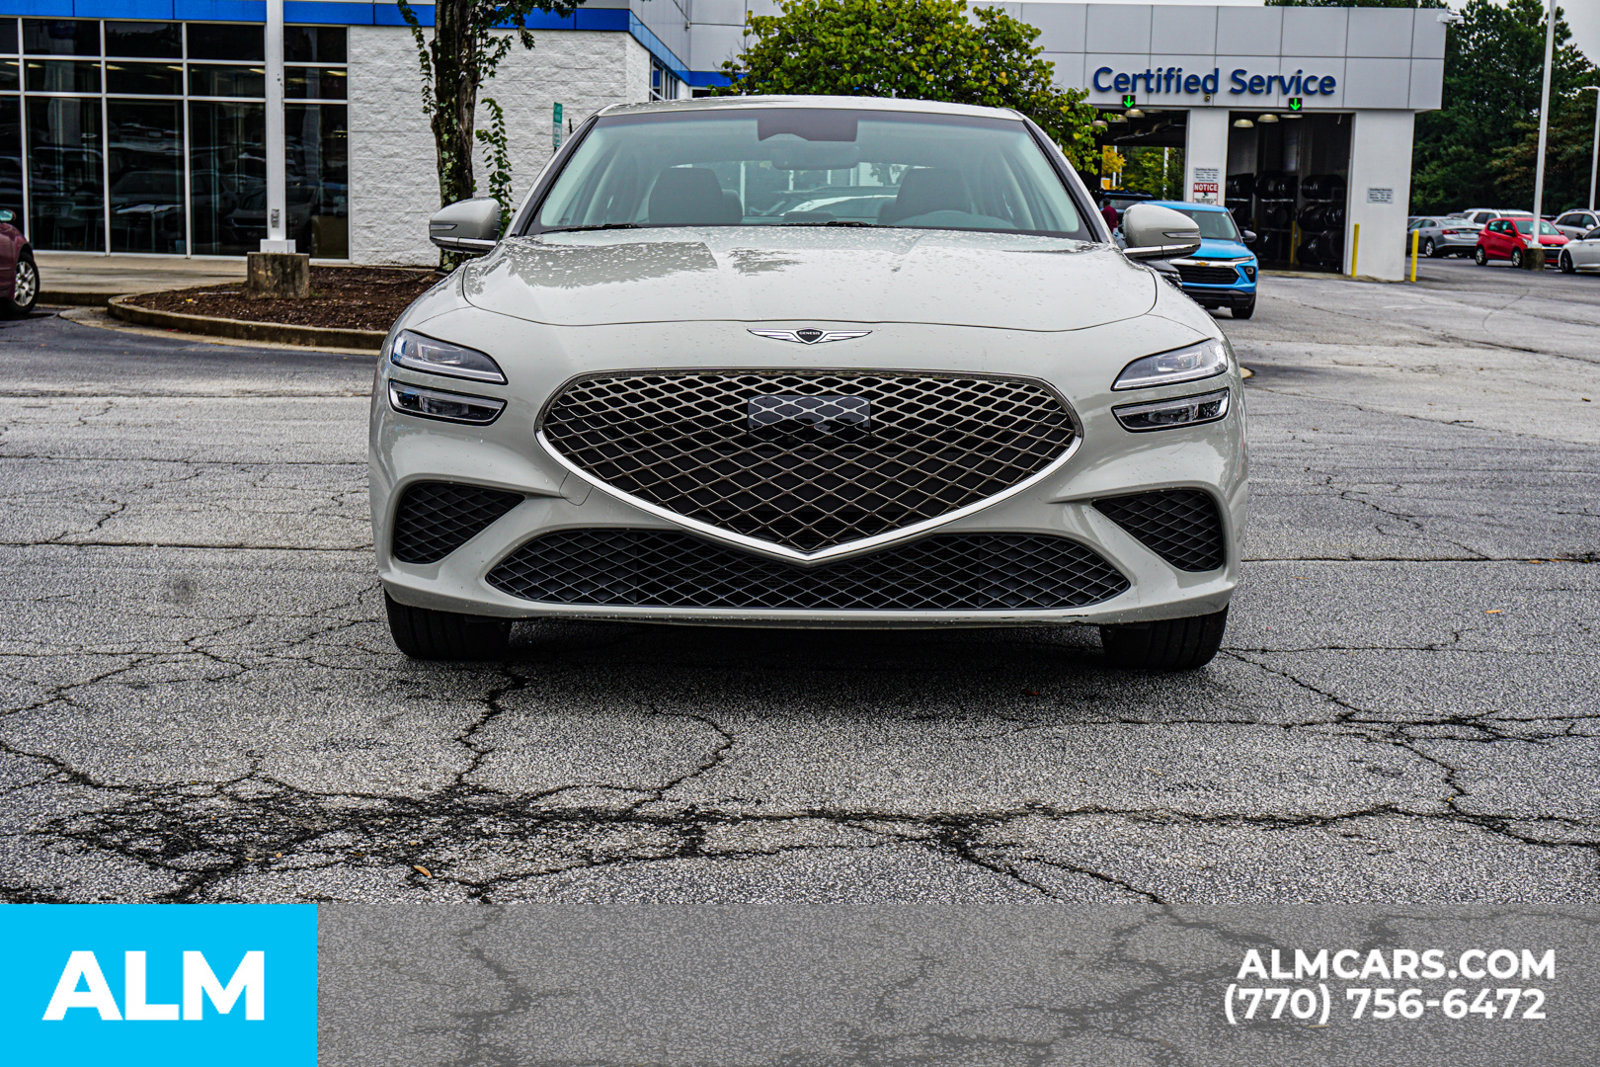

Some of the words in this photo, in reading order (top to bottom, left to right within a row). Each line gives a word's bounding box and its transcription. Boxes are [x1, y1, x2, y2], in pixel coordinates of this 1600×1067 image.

[1093, 67, 1220, 94] Certified
[1230, 69, 1337, 96] Service
[1194, 183, 1218, 192] NOTICE
